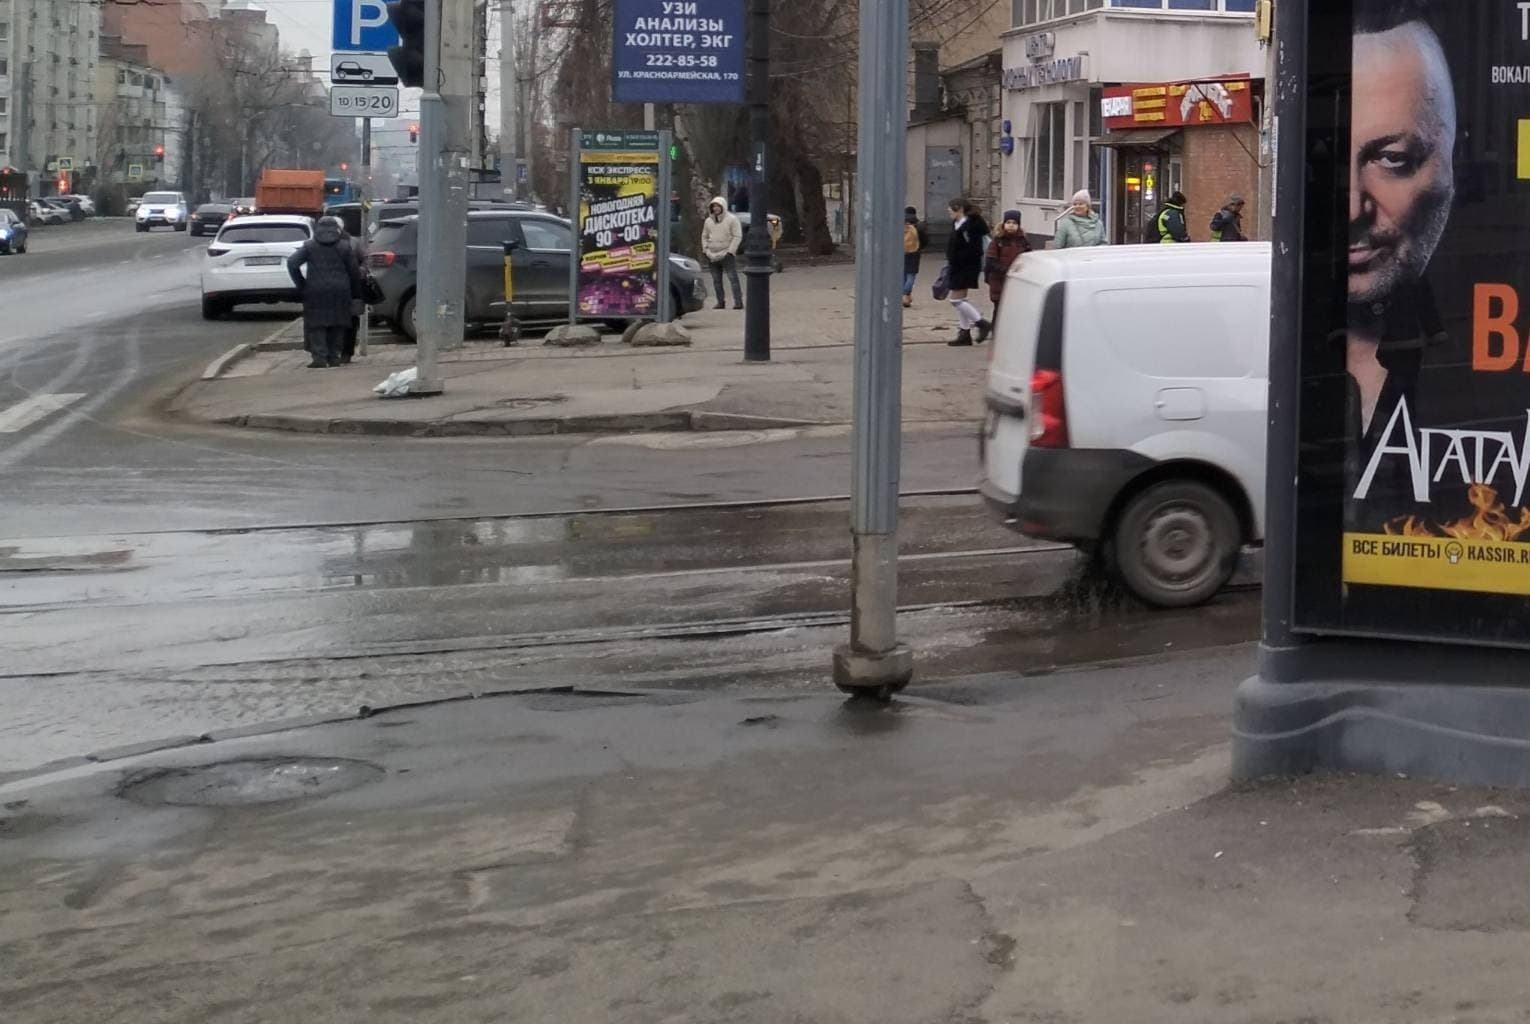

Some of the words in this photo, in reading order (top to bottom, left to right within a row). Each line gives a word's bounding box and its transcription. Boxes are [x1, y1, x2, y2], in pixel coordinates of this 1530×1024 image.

[662, 2, 697, 15] УЗИ
[634, 17, 724, 32] АНАЛИЗЫ
[625, 34, 696, 49] ХОЛТЕР,
[700, 34, 734, 48] ЭКГ
[646, 55, 718, 67] 222-85-58
[617, 70, 632, 79] УЛ.
[633, 70, 721, 81] КРАСНОАРМЕЙСКАЯ,
[723, 72, 739, 80] 170
[1491, 65, 1530, 85] ВОКАЛ
[371, 96, 391, 109] 20
[588, 166, 605, 174] КСК
[606, 166, 651, 174] ЭКСПРЕСС
[630, 177, 651, 185] 19:00
[591, 195, 644, 215] НОВОГОДНЯЯ
[584, 205, 655, 235] ДИСКОТЕКА
[1352, 539, 1378, 556] ВСЕ
[1382, 541, 1441, 559] БИЛЕТЫ
